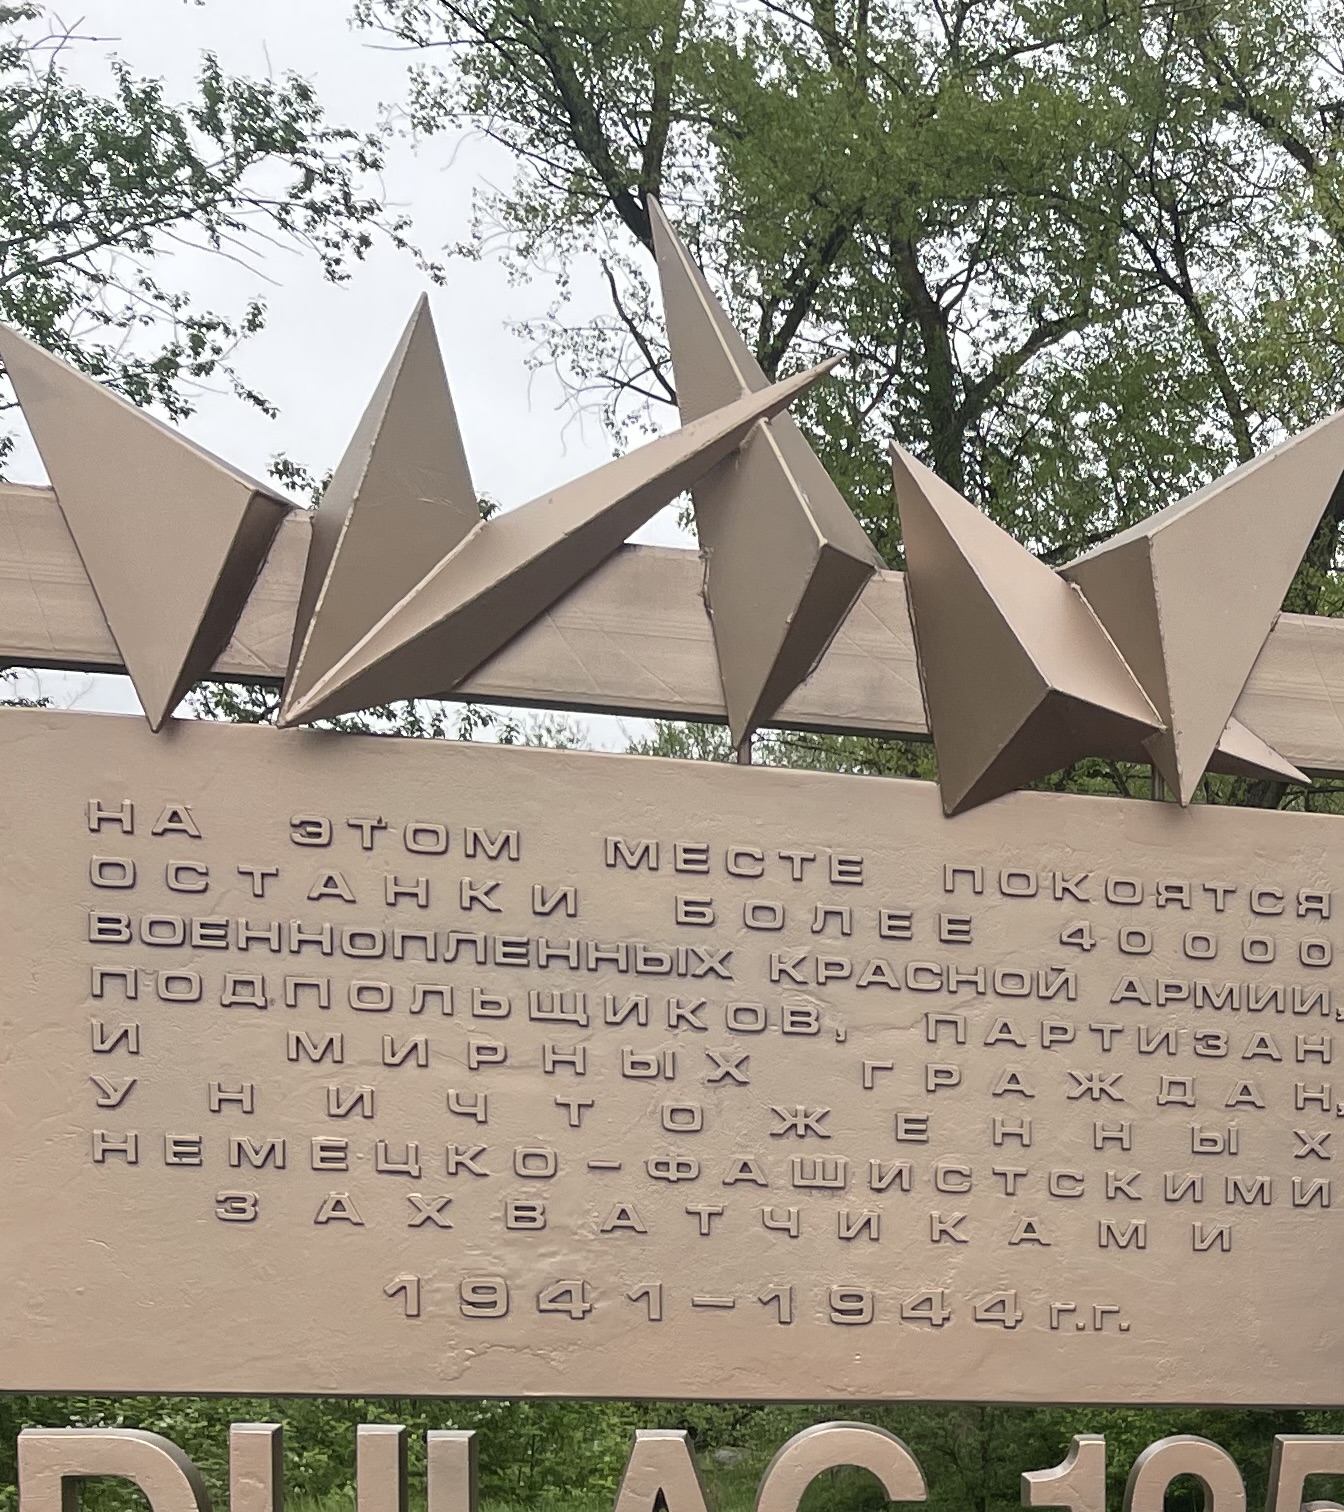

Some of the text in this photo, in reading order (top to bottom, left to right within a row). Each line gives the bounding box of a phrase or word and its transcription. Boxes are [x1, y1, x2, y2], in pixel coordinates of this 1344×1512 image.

[86, 799, 1332, 919] НА ЭТОМ МЕСТЕ ПОКОЯТСЯ
[90, 855, 1333, 967] ОСТАНКИ БОЛЕЕ 40000
[88, 910, 733, 981] ВОЕННОПЛЕННЫХ
[769, 952, 1078, 1002] КРАСНОЙ
[91, 965, 1333, 1064] ПОДПОЛЬЩИКОВ, ПАРТИЗАН
[91, 1019, 139, 1055] И
[286, 1030, 750, 1085] МИРНЫХ
[90, 1075, 1332, 1160] УНИЧТОЖЕННЫХ
[91, 1129, 1332, 1209] НЕМЕЦКО-ФАШИСТСКИМИ
[215, 1191, 1232, 1253] ЗАХВАТЧИКАМИ
